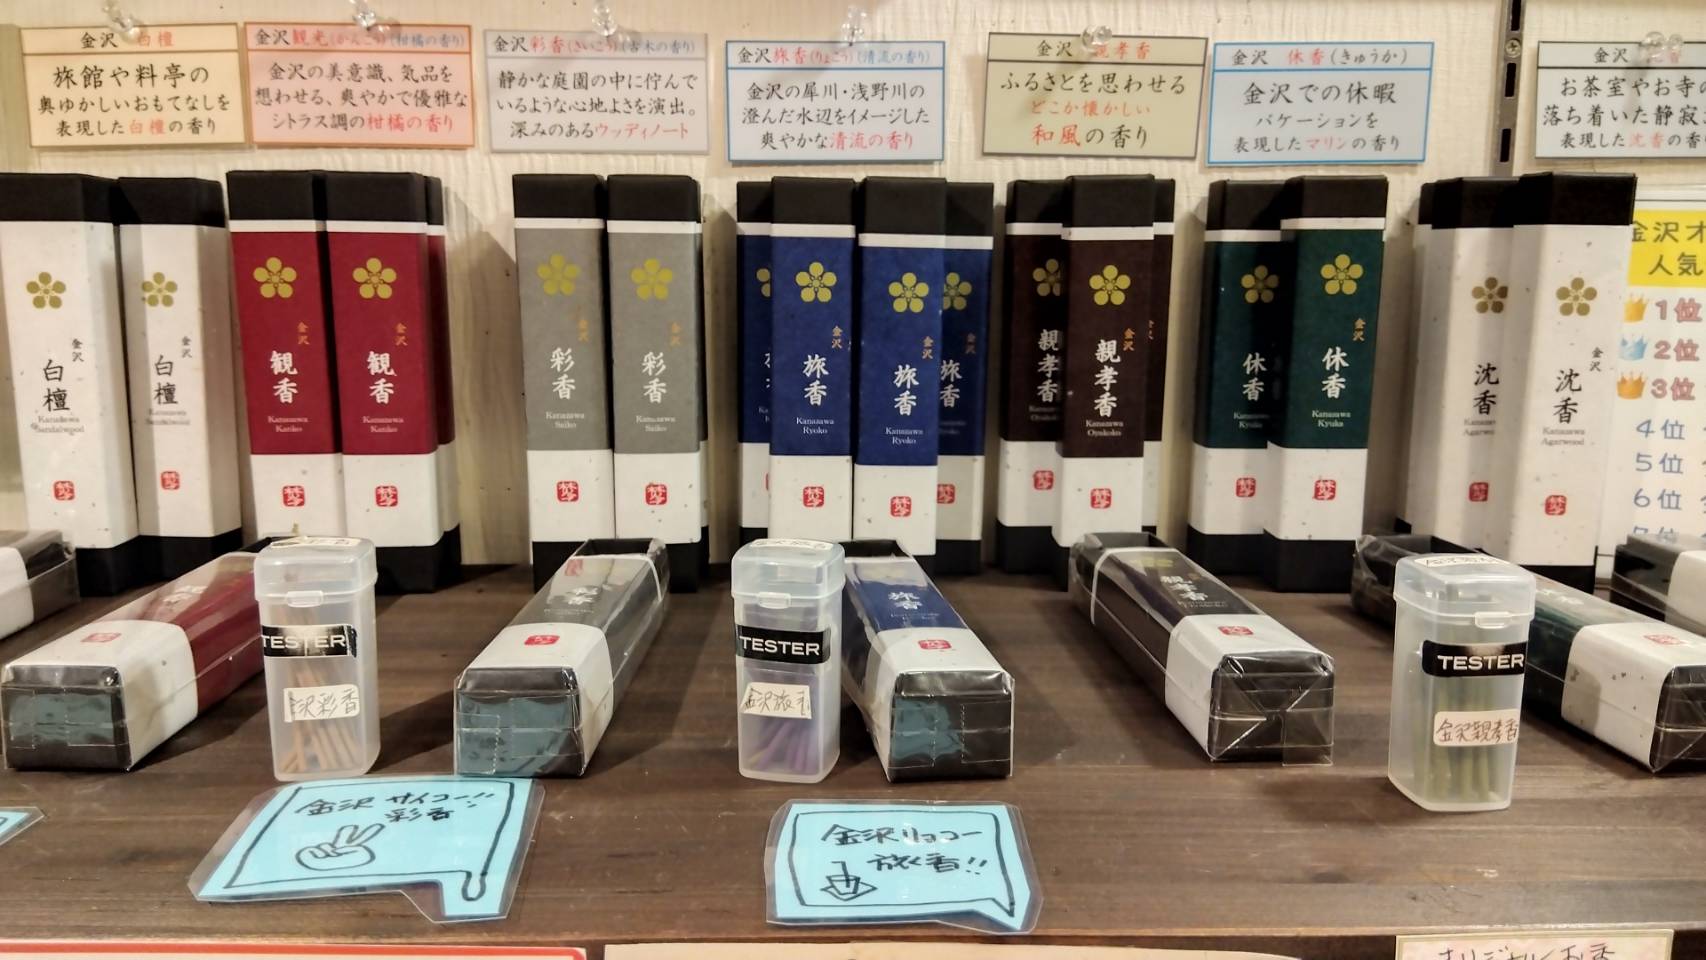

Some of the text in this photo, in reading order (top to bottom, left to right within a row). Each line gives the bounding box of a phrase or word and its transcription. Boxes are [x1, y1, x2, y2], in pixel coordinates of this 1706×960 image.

[81, 31, 118, 49] 金沢
[1036, 39, 1073, 58] 金沢
[1232, 48, 1408, 66] 金沢 休香(きゅうか)
[1593, 46, 1629, 64] 金沢
[52, 63, 210, 88] 旅館や料亭の
[269, 61, 454, 84] 金沢の美意識、気品を
[498, 70, 699, 91] 静かな庭園の中に佇んで
[1001, 73, 1186, 95] ふるさとを思わせる
[254, 89, 469, 109] 想わせる、爽やかで優雅な
[747, 81, 926, 101] 金沢の犀川・浅野川の
[1243, 80, 1398, 105] 金沢での休暇
[39, 94, 230, 116] 奥ゆかしいおもてなしを
[496, 96, 698, 118] いるような心地よさを演出。
[742, 106, 931, 127] 澄んだ水辺をイメージした
[1030, 100, 1152, 117] どこか懐かしい
[1543, 104, 1706, 127] 落ち着いた静寂
[56, 118, 216, 138] 表現した白檀の香り
[271, 112, 454, 133] シトラス調の柑橘の香り
[510, 121, 689, 140] 深みのあるウッディノート
[1256, 112, 1379, 129] バケーションを
[760, 132, 914, 151] 爽やかな清流の香り
[1031, 125, 1149, 149] 和風の香り
[1233, 134, 1400, 154] 表現したマリンの香り
[1561, 131, 1706, 150] 表現した沈香の香
[1648, 252, 1704, 277] 人気
[1655, 297, 1703, 323] 1位
[831, 325, 843, 349] 金沢
[922, 335, 934, 360] 金沢
[1589, 346, 1604, 372] 金沢
[1653, 338, 1700, 363] 2位
[270, 350, 299, 404] 観香
[366, 350, 397, 404] 観香
[550, 347, 576, 400] 彩香
[1037, 328, 1060, 403] 親孝香
[1242, 352, 1267, 401] 休香
[1321, 346, 1350, 399] 休香
[42, 359, 70, 412] 白檀
[153, 355, 179, 405] 白檀
[641, 351, 667, 404] 彩香
[802, 353, 830, 407] 旅香
[1094, 339, 1122, 417] 親孝香
[1474, 363, 1499, 415] 沈香
[1651, 377, 1696, 401] 3位
[893, 364, 920, 416] 旅香
[1553, 368, 1583, 424] 沈香
[1636, 418, 1685, 441] 4位
[1635, 452, 1684, 474] 5位
[1633, 488, 1682, 511] 6位
[262, 634, 347, 650] TESTER
[740, 636, 820, 657] TESTER
[1437, 653, 1525, 671] TESTER
[295, 797, 376, 816] 金沢
